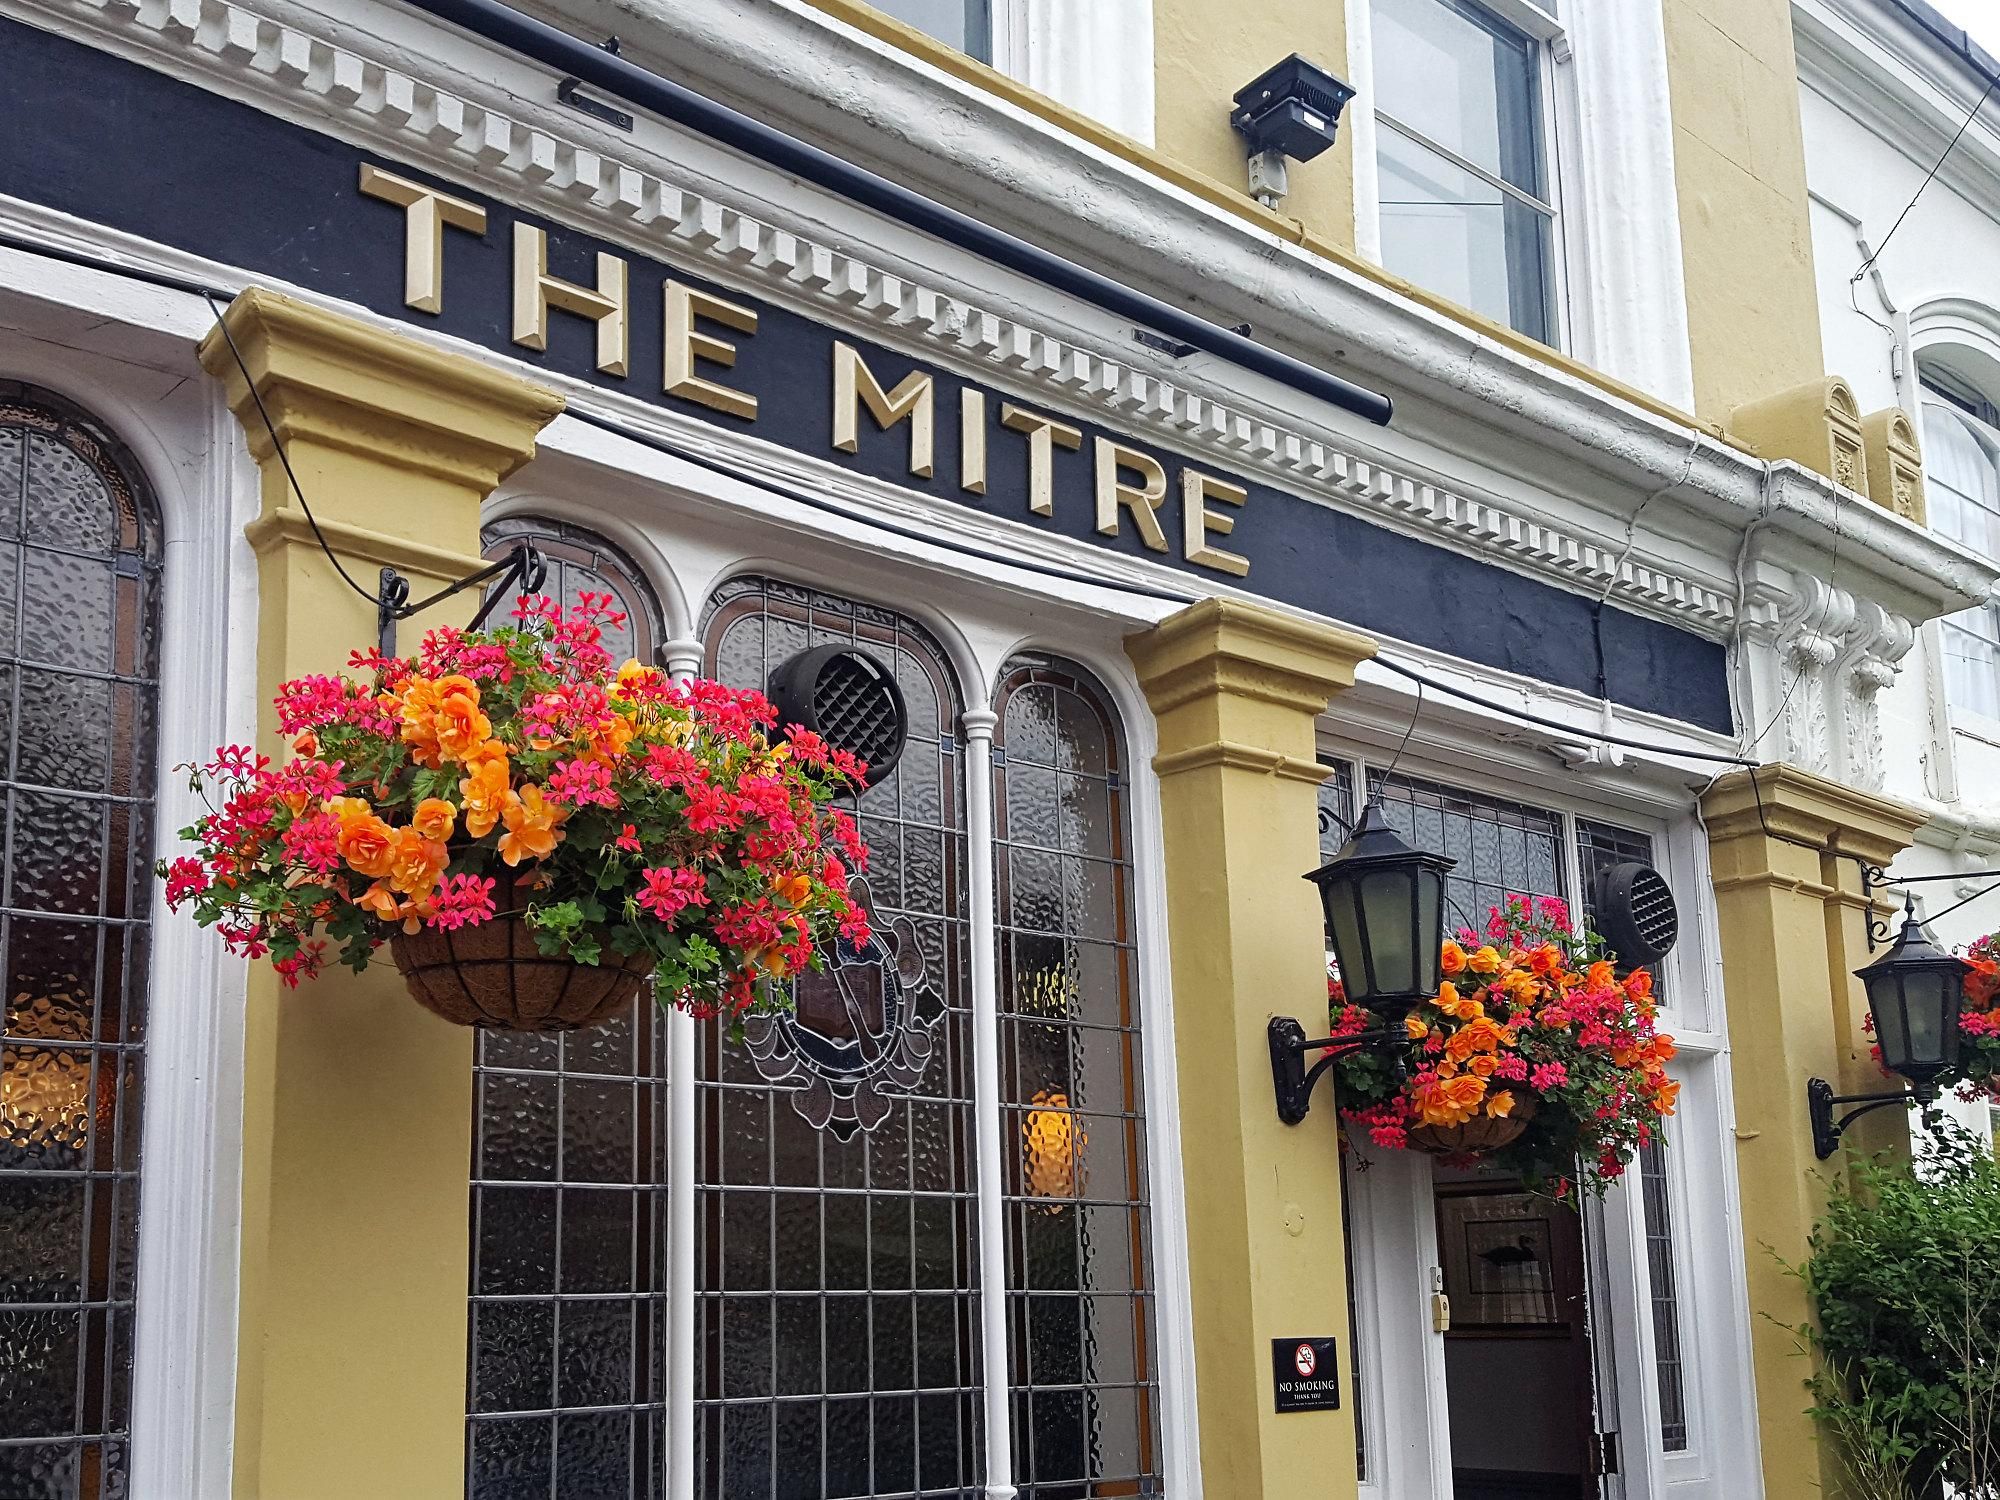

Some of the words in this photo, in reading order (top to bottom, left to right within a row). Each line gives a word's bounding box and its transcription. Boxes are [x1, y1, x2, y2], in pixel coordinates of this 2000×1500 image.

[359, 162, 758, 421] THE
[832, 340, 1250, 577] MITRE
[1279, 1382, 1292, 1392] NO
[1295, 1380, 1335, 1392] SMOKING
